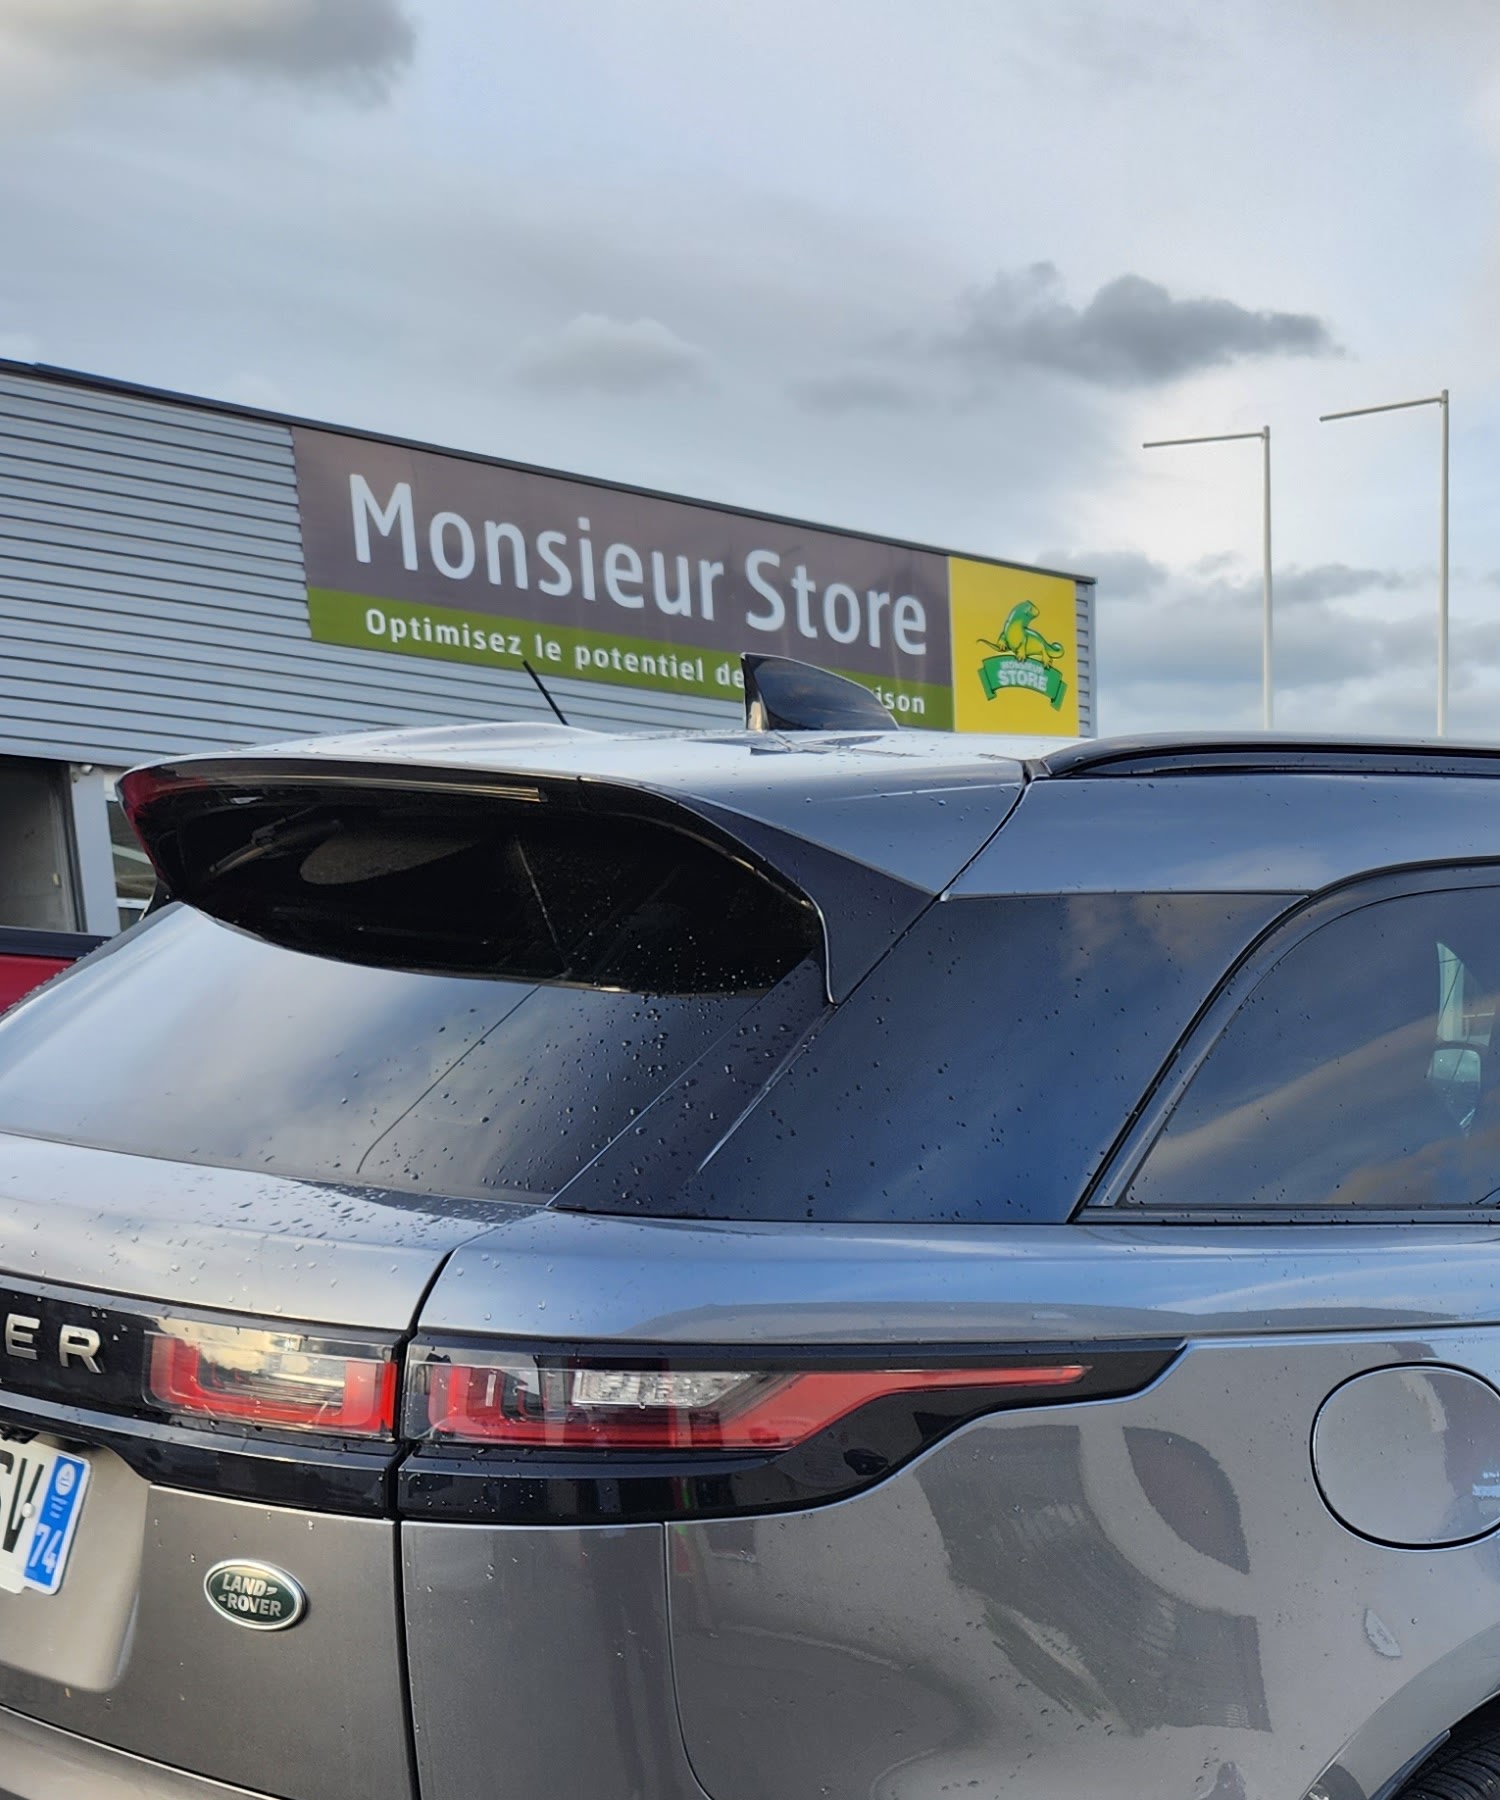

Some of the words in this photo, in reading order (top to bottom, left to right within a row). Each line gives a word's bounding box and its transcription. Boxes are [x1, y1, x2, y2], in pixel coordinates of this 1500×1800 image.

[350, 473, 724, 621] Monsieur
[745, 549, 927, 656] Store
[365, 608, 523, 657] Optimisez
[535, 633, 562, 660] le
[574, 644, 704, 683] potentiel
[715, 661, 745, 689] de
[873, 685, 925, 715] ison
[997, 669, 1048, 692] STORE
[29, 1522, 63, 1574] 74
[222, 1573, 268, 1597] LAND
[227, 1592, 282, 1617] ROVER
